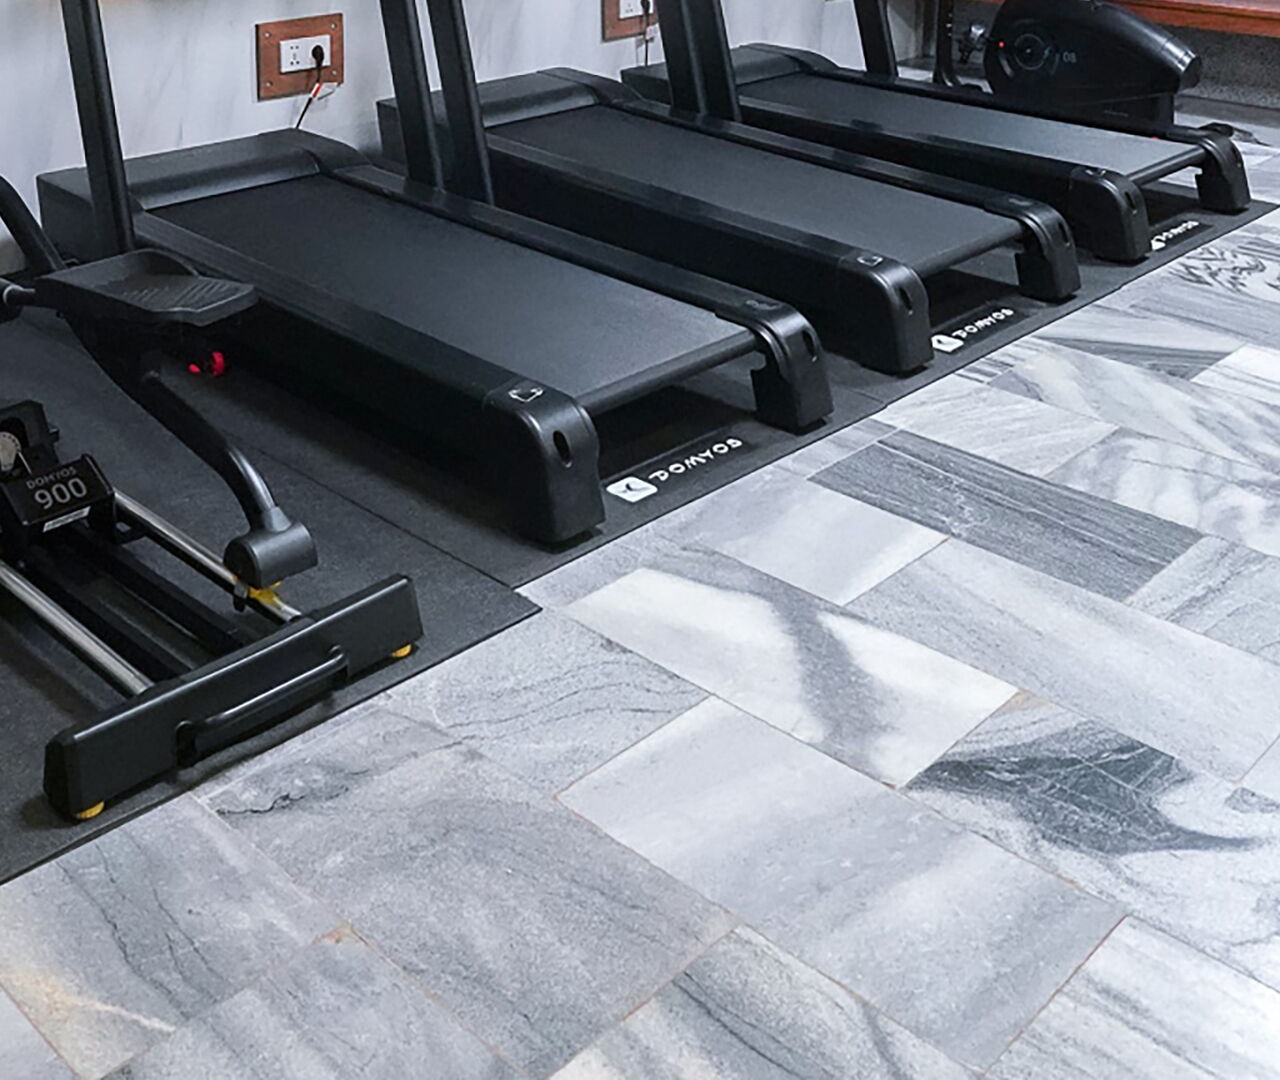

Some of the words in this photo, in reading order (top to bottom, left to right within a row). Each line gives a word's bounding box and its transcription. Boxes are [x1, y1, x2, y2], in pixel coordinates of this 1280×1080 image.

[648, 437, 743, 481] DOMYOS
[26, 466, 77, 489] DOMYOS
[34, 477, 87, 510] 900
